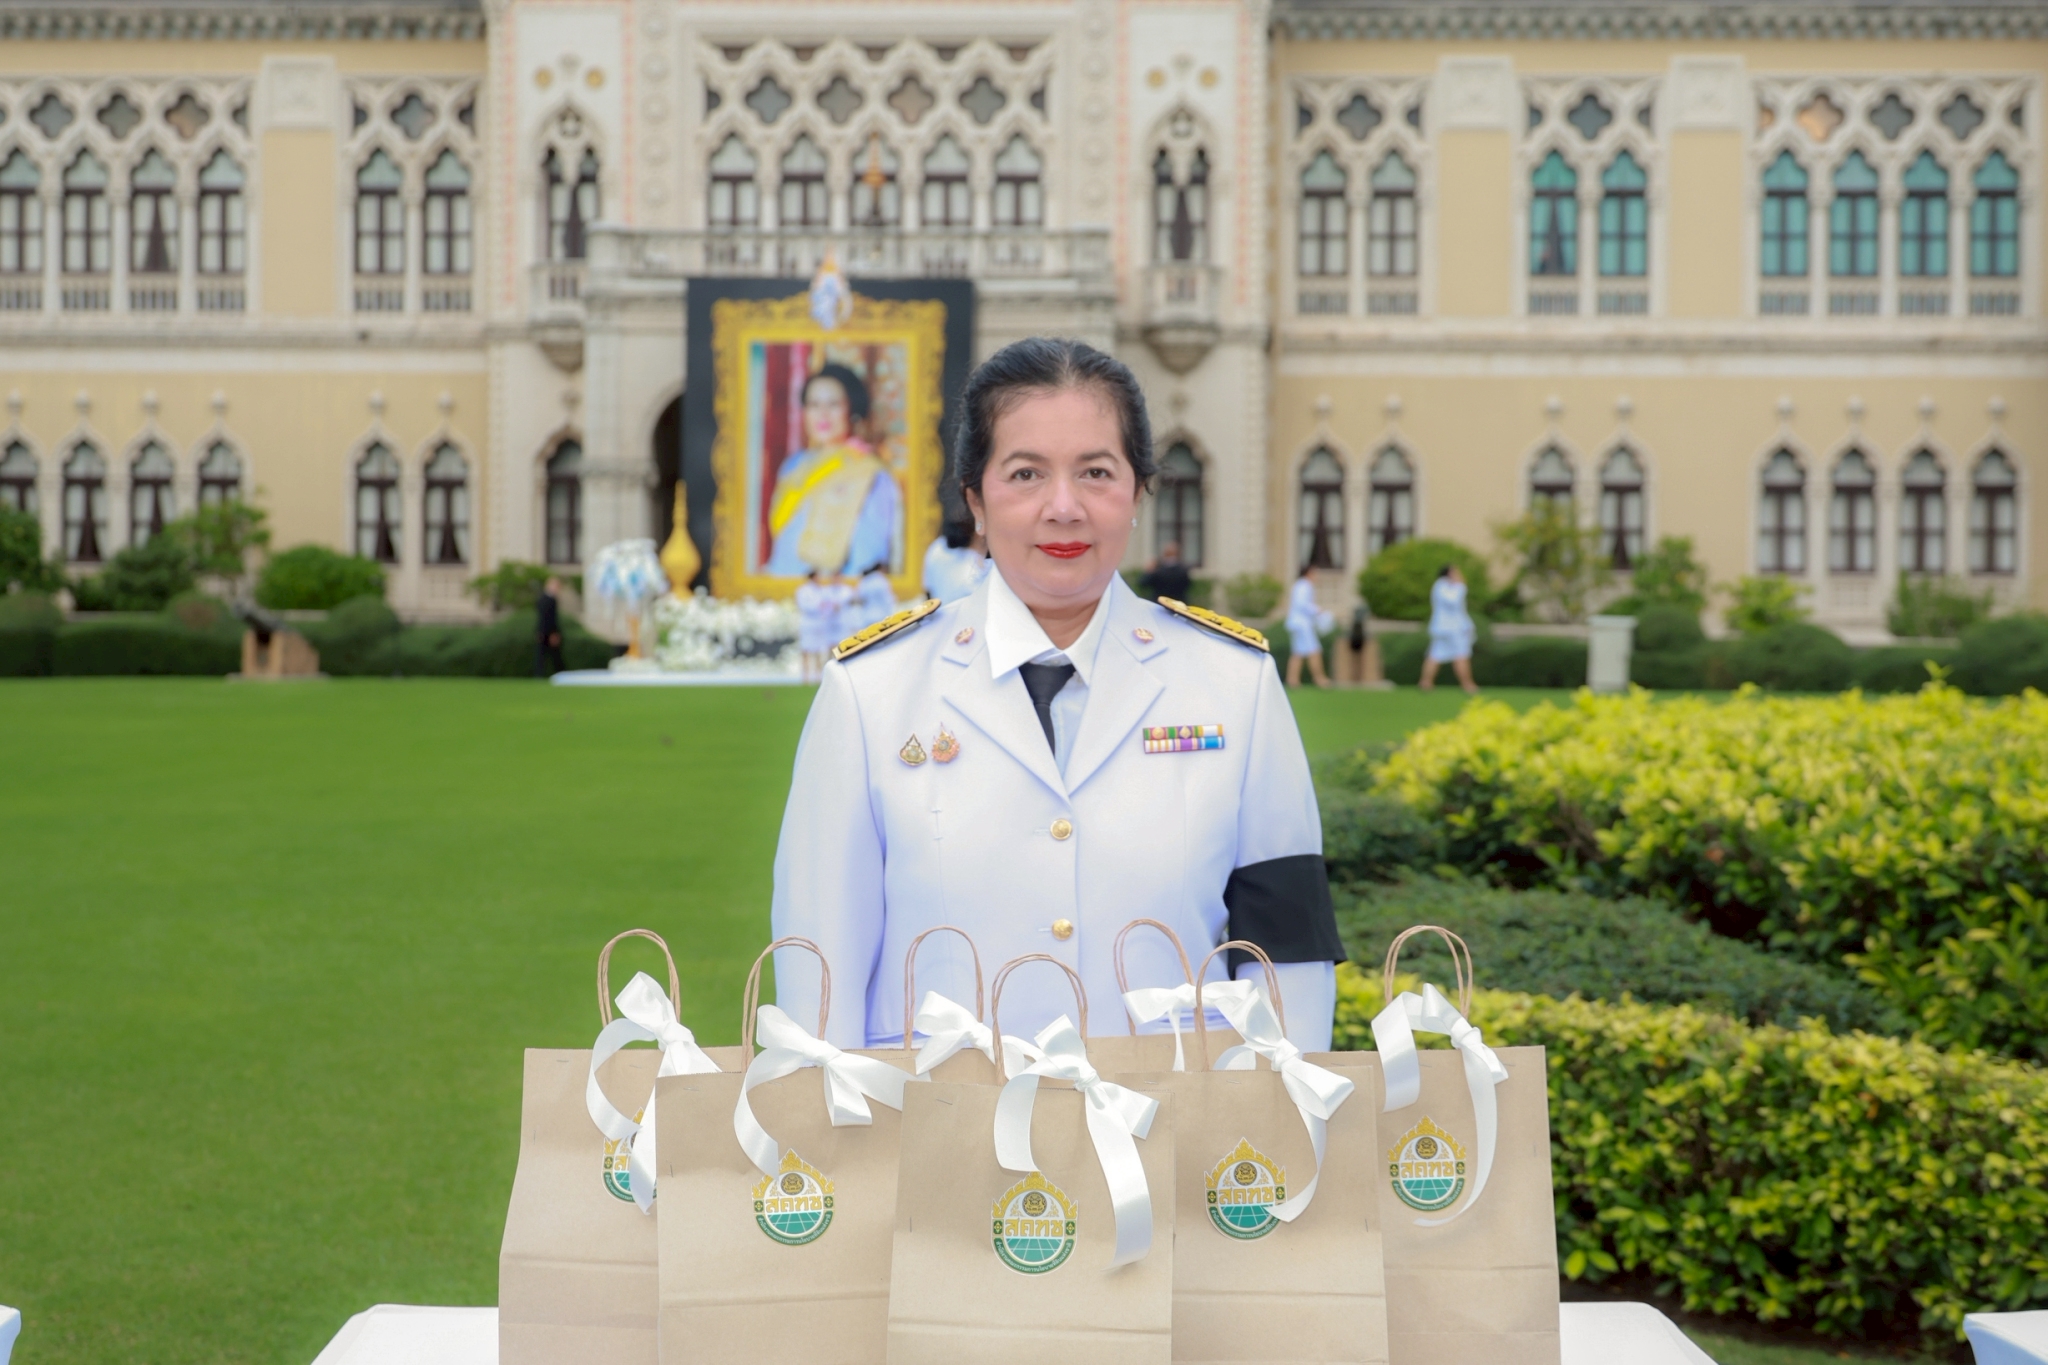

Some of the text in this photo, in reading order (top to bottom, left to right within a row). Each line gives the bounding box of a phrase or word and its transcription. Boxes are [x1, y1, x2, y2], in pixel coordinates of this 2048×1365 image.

[1401, 1160, 1455, 1178] สคทช
[766, 1195, 822, 1213] สคทช
[1219, 1186, 1275, 1205] สคทช
[1005, 1217, 1064, 1237] สคทช
